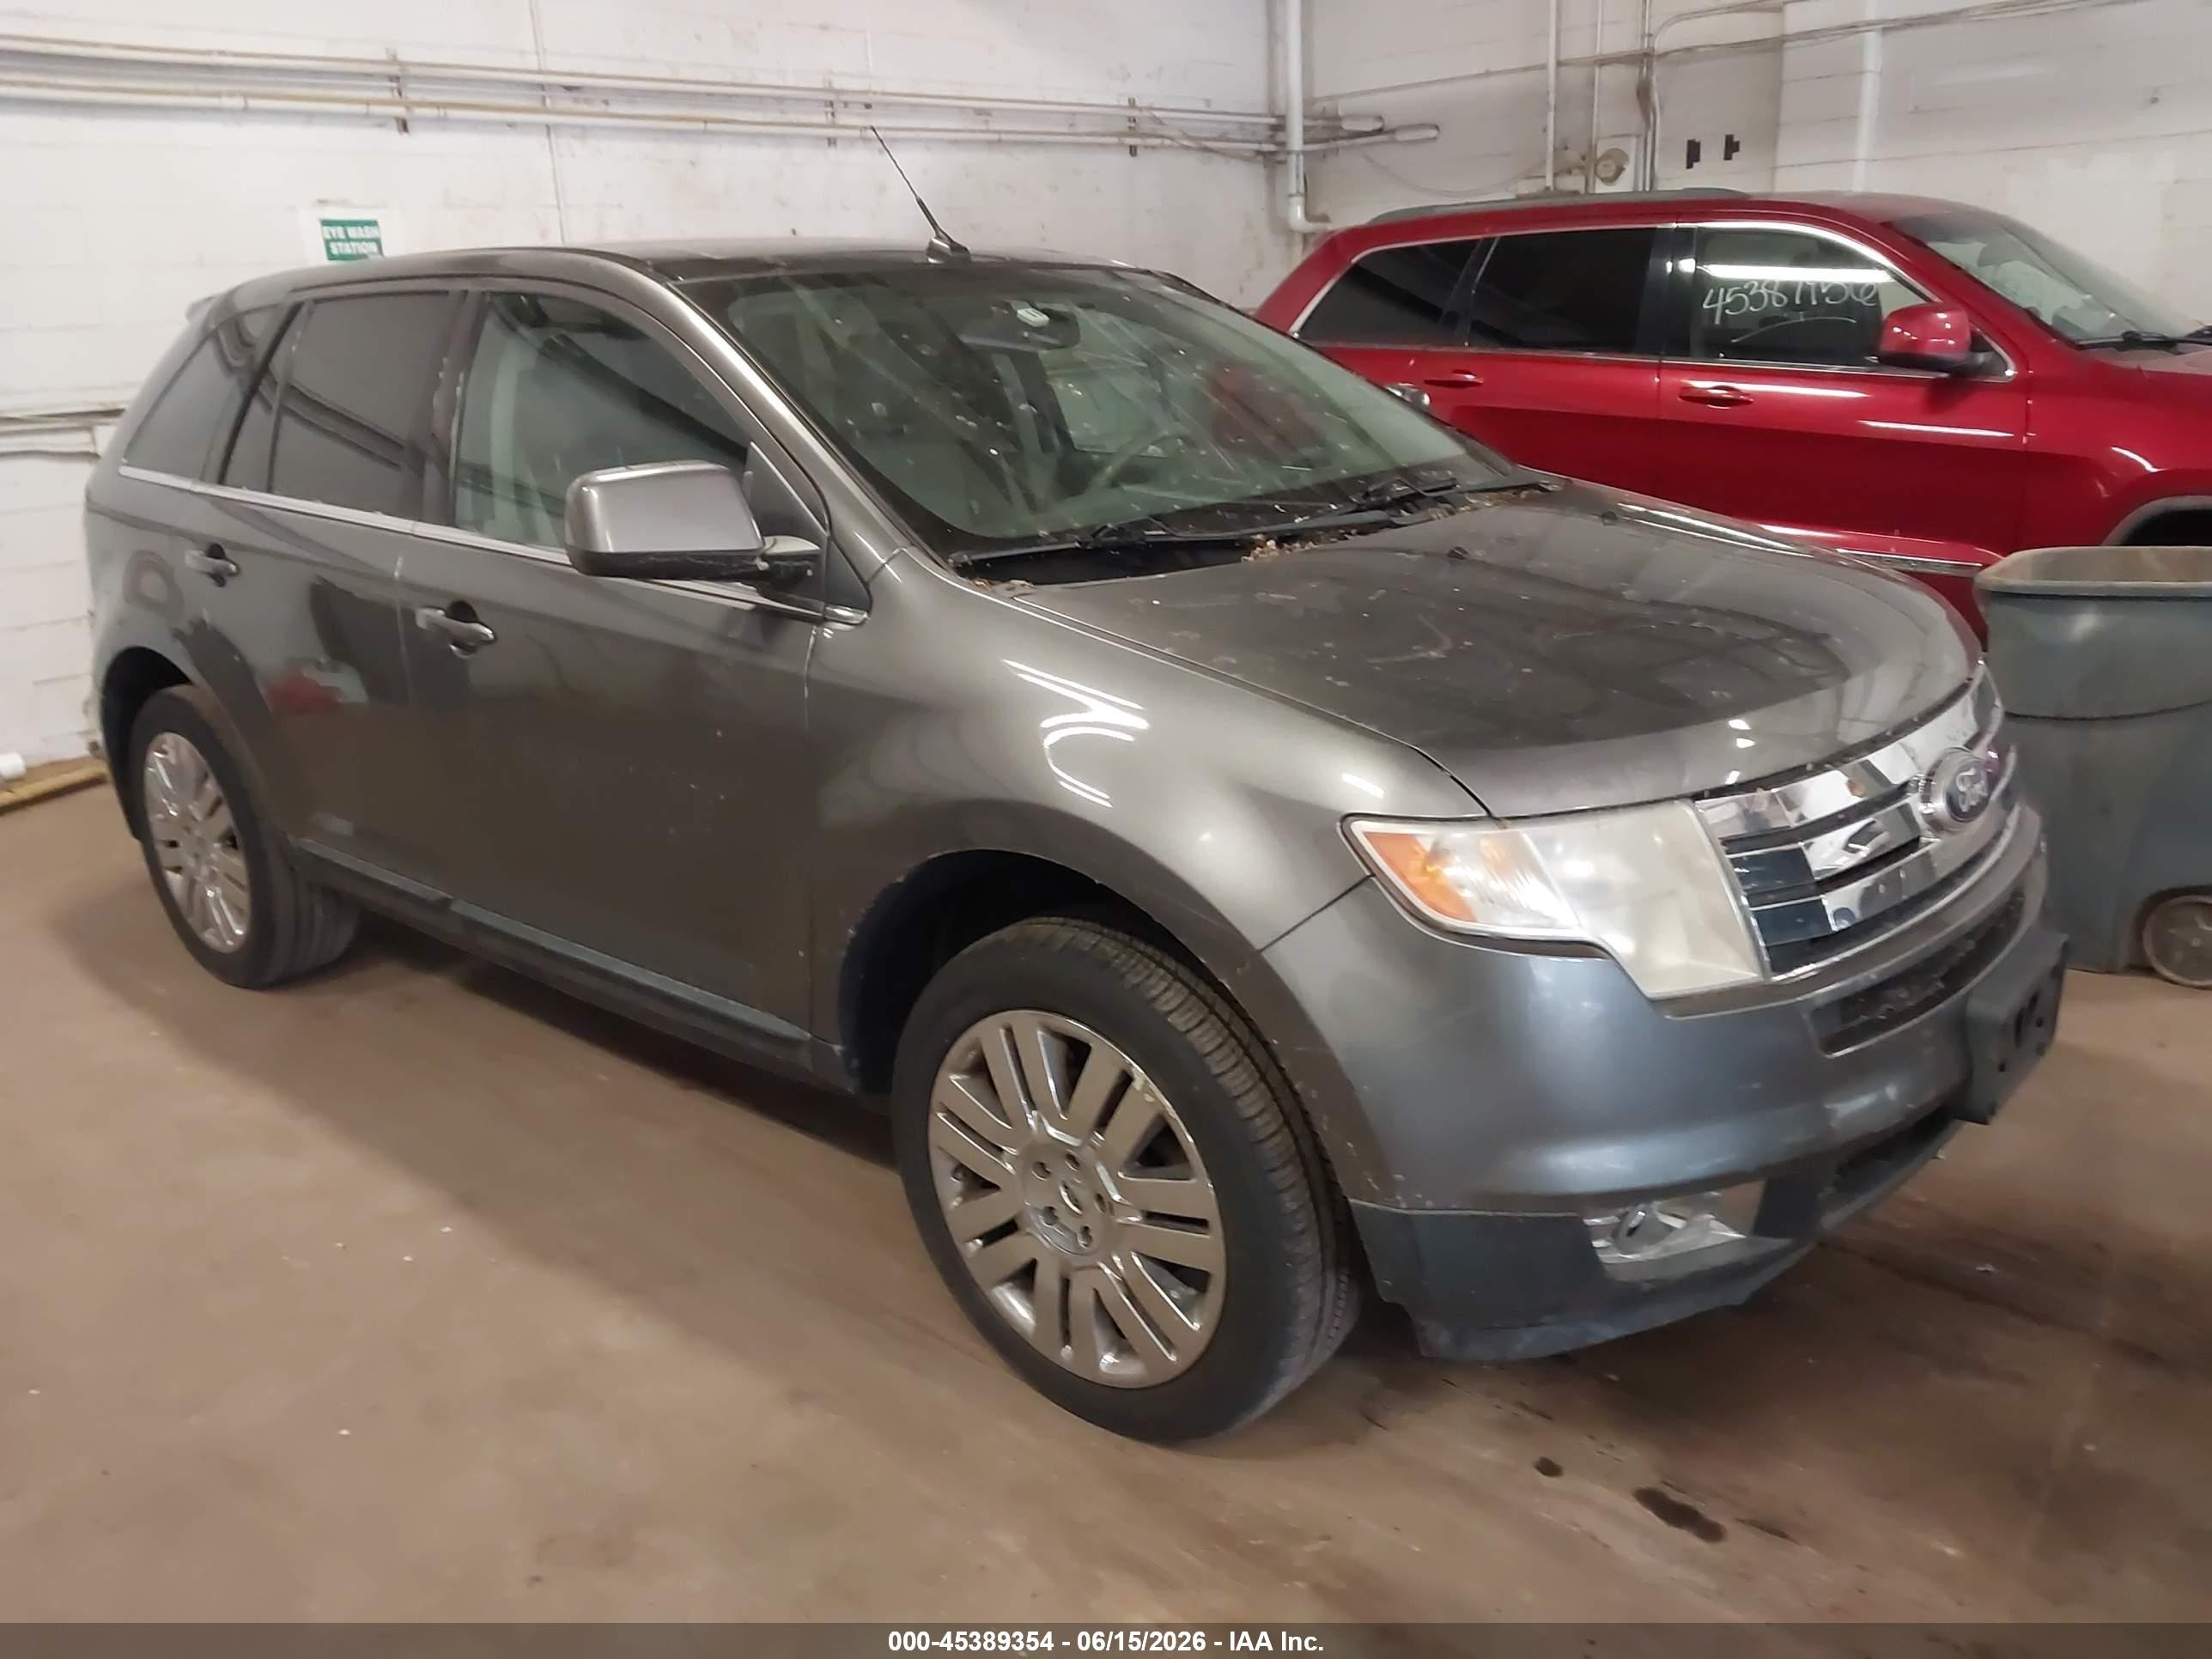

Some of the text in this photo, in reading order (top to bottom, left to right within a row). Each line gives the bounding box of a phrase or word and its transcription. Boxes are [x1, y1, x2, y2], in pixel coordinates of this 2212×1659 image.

[322, 226, 380, 239] EYE WASH
[329, 241, 378, 254] STATION
[1956, 767, 1988, 812] Ford
